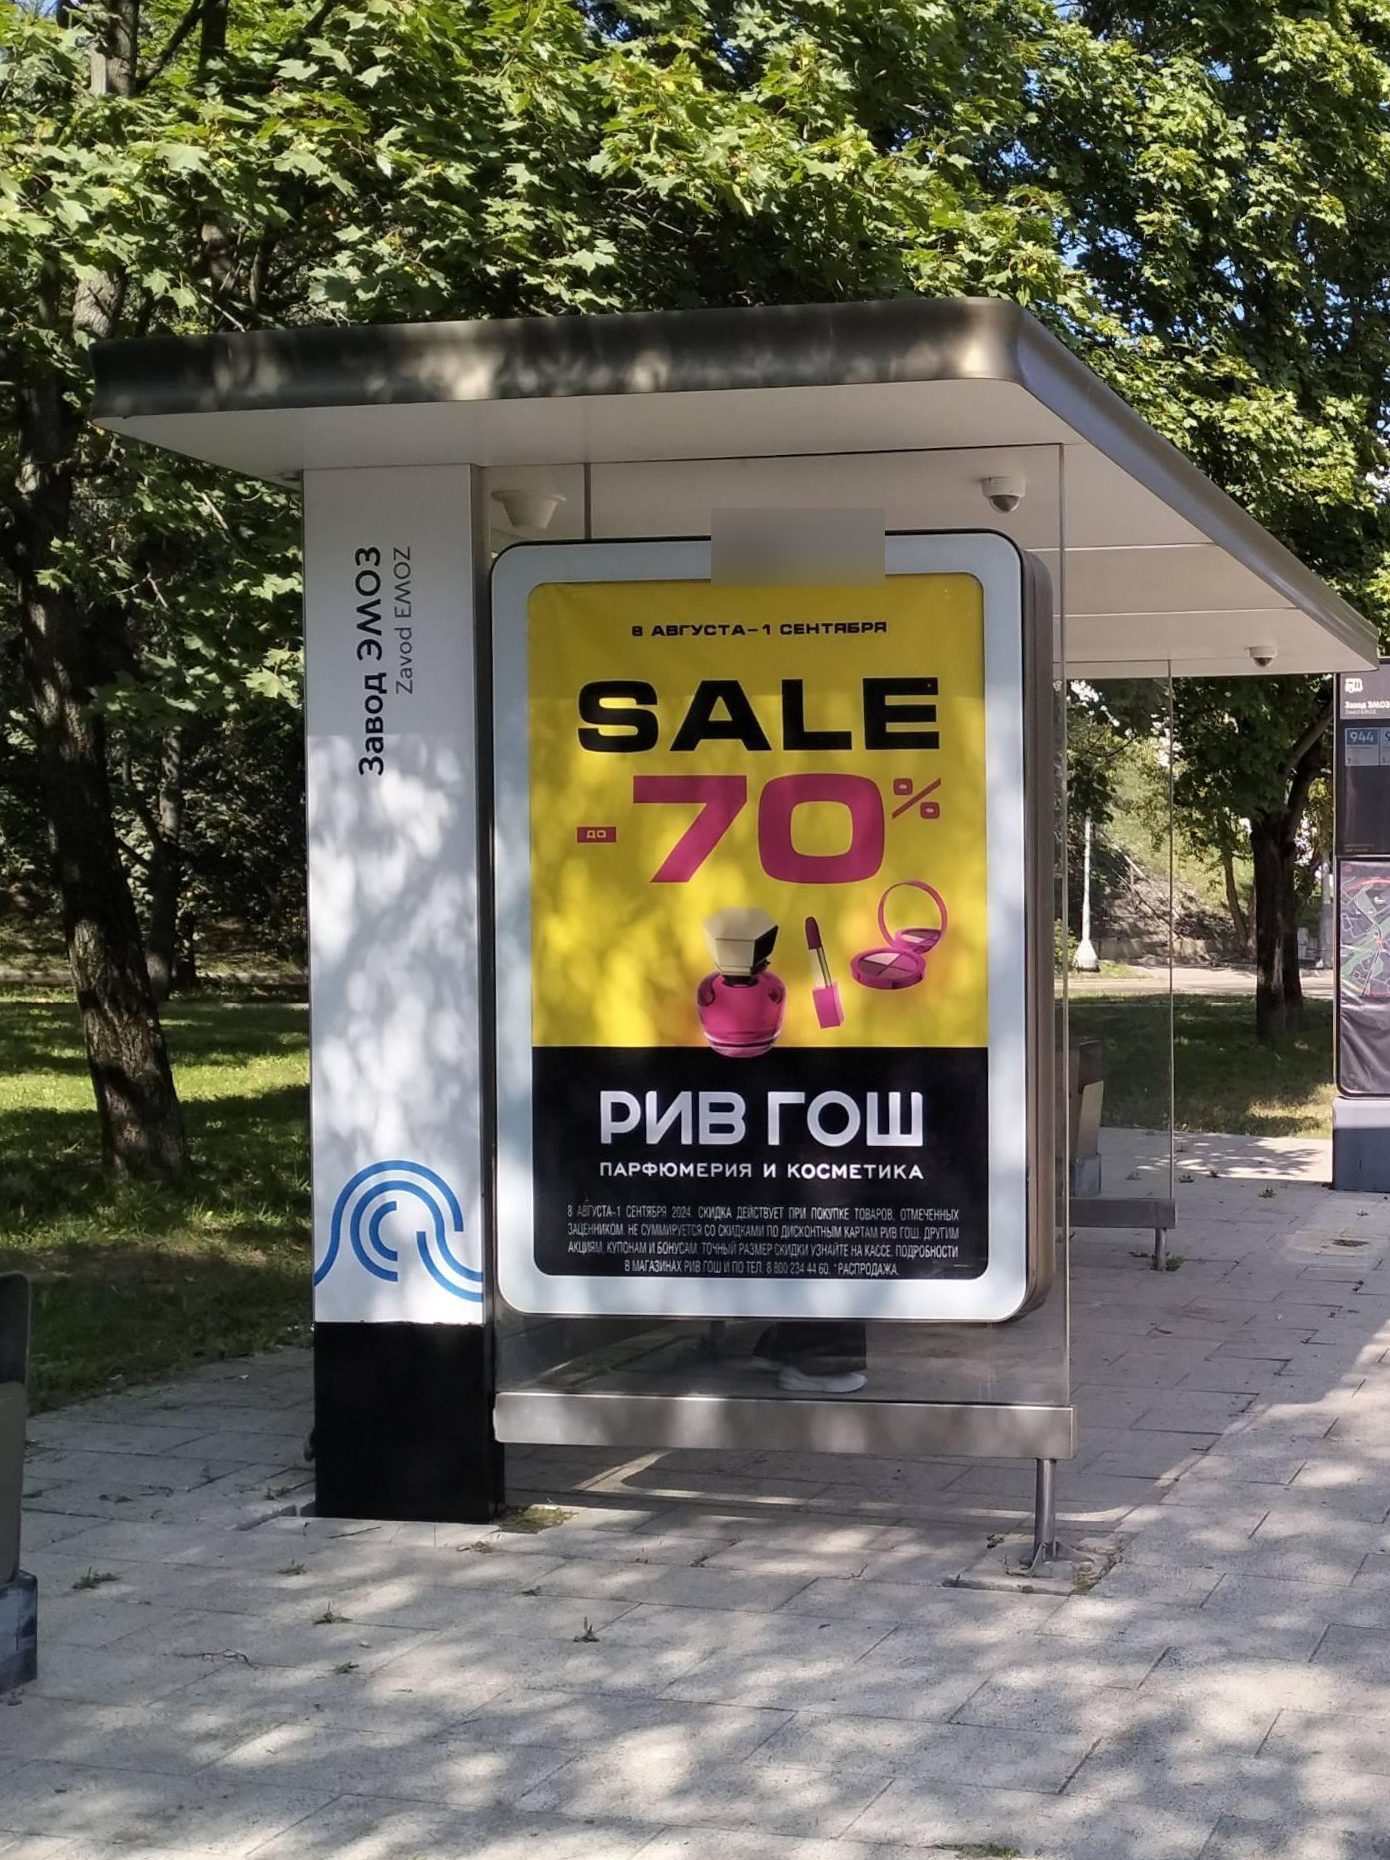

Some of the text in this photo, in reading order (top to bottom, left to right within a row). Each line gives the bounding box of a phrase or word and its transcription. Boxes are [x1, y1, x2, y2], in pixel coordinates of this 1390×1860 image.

[393, 546, 413, 694] Zavod EMOZ
[631, 625, 643, 637] 8
[779, 622, 887, 635] СЕНТЯБРЯ
[355, 547, 388, 776] Завод ЭМОЗ
[577, 677, 940, 753] SALE
[1350, 731, 1374, 743] 944
[600, 1090, 923, 1147] РИВ ГОШ
[600, 1162, 924, 1179] ПАРФЮМЕРИЯ И КОСМЕТИКА
[567, 1205, 573, 1217] 8
[626, 1205, 667, 1218] СЕНТЯБРЯ
[698, 1206, 732, 1220] СКИДКА
[736, 1205, 784, 1220] ДЕЙСТВУЕТ
[788, 1207, 807, 1219] ПРИ
[811, 1207, 850, 1220] ПОКУПКЕ
[900, 1208, 959, 1221] ОТМЕЧЕННЫХ
[628, 1224, 638, 1236] НЕ
[640, 1223, 702, 1237] СУММИРУЕТСЯ
[704, 1224, 716, 1237] СО
[718, 1224, 764, 1238] СКИДКАМИ
[767, 1225, 779, 1237] ПО
[781, 1225, 842, 1239] ДИСКОНТНЫМ
[844, 1226, 878, 1239] КАРТАМ
[880, 1227, 897, 1239] РИВ
[923, 1227, 959, 1241] ДРУГИМ
[607, 1241, 647, 1253] КУПОНАМ
[649, 1241, 655, 1253] И
[702, 1241, 737, 1255] ТОЧНЫЙ
[739, 1243, 772, 1256] РАЗМЕР
[775, 1244, 808, 1257] СКИДКИ
[811, 1243, 849, 1257] УЗНАЙТЕ
[851, 1246, 862, 1257] НА
[896, 1245, 958, 1259] ПОДРОБНОСТИ
[624, 1260, 630, 1272] В
[632, 1260, 682, 1273] МАГАЗИНАХ
[684, 1261, 700, 1273] РИВ
[703, 1261, 721, 1274] ГОШ
[723, 1261, 730, 1273] И
[732, 1262, 744, 1274] ПО
[766, 1262, 772, 1274] 8
[773, 1262, 788, 1275] 800
[790, 1262, 804, 1275] 234
[806, 1263, 816, 1275] 44
